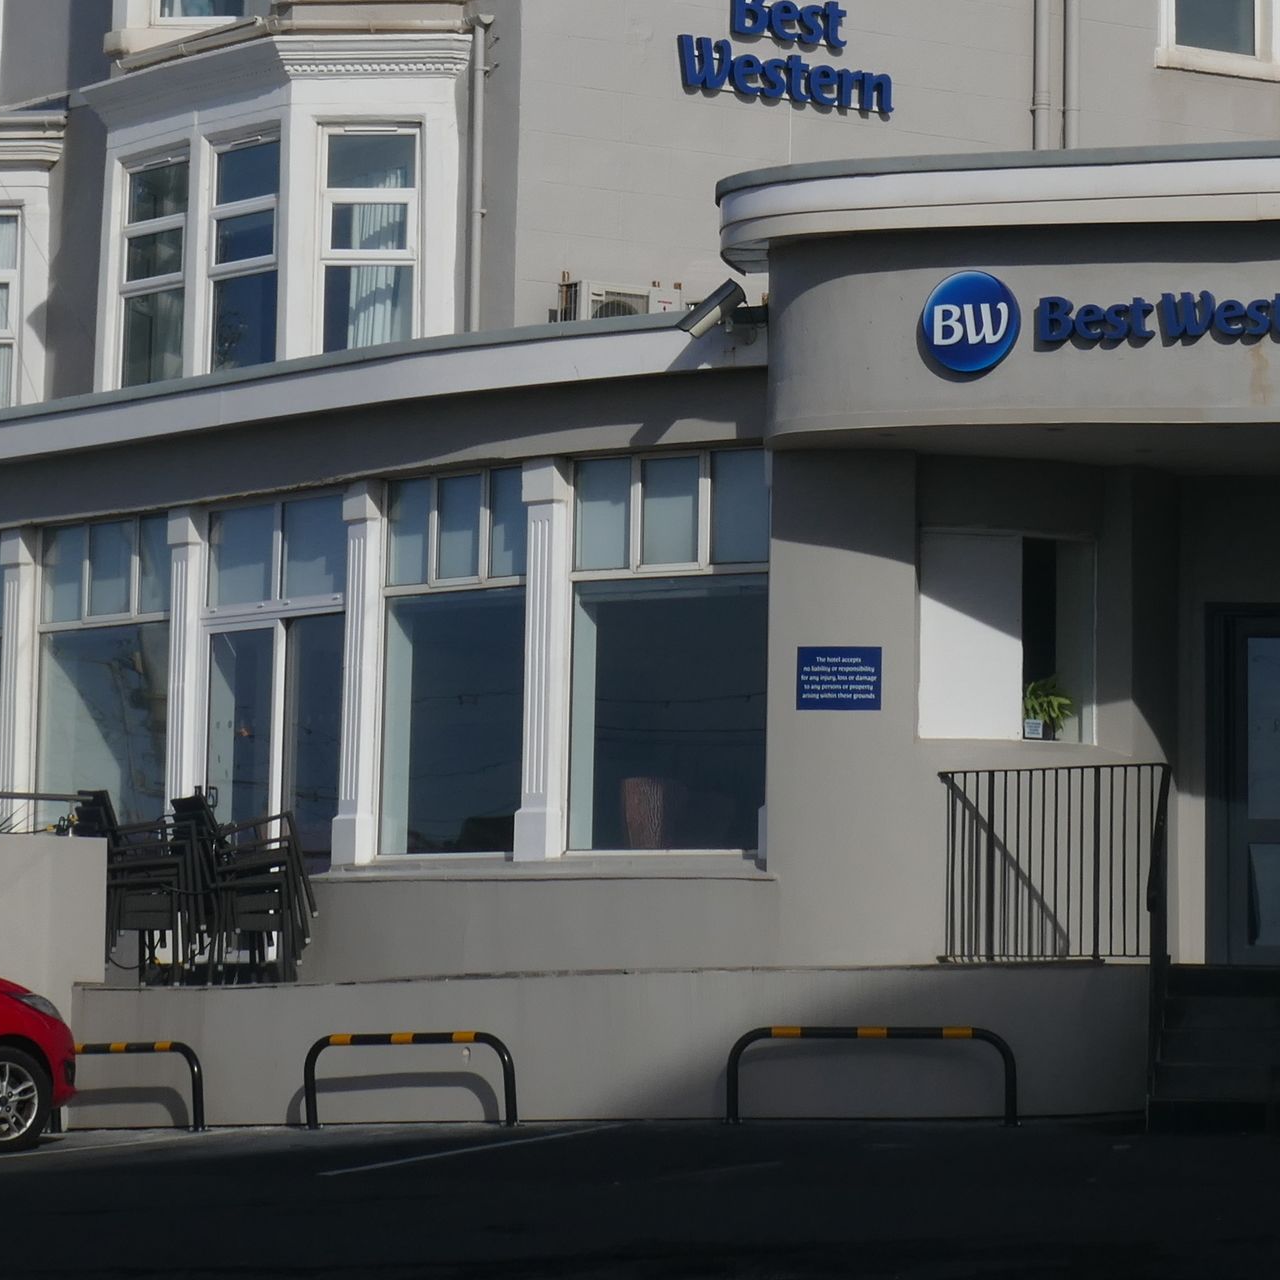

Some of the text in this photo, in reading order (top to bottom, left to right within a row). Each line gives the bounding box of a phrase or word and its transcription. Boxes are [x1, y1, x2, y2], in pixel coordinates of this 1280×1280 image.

[677, 34, 895, 114] Western
[933, 301, 1009, 346] BW
[1035, 296, 1154, 343] Best
[838, 665, 875, 673] responsibility
[855, 674, 877, 682] damage
[853, 692, 876, 700] grounds
